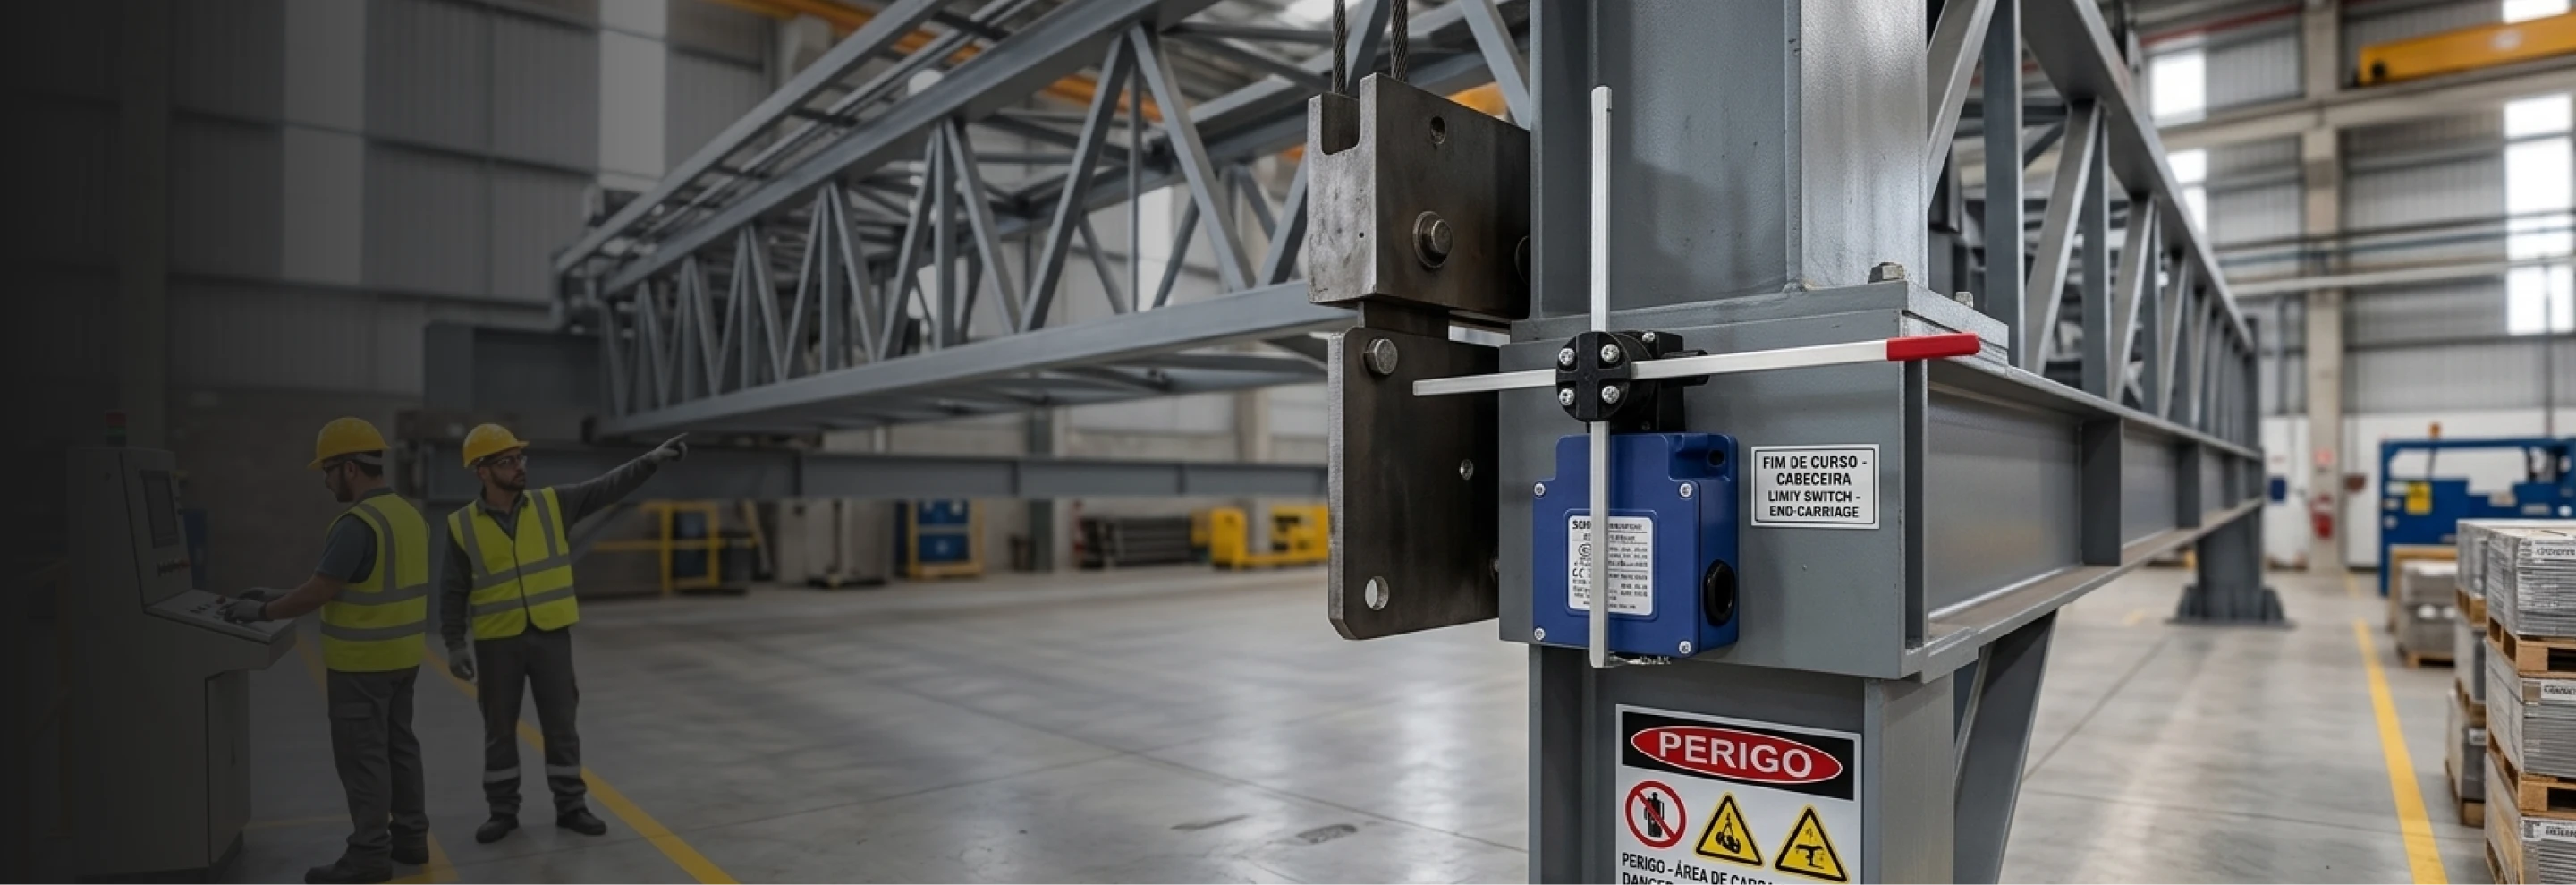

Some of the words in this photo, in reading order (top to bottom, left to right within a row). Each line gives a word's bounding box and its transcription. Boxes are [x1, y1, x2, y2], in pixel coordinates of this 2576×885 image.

[1763, 456, 1786, 469] FIM
[1791, 456, 1808, 469] DE
[1810, 455, 1858, 469] CURSO
[1776, 472, 1852, 486] CABECEIRA
[1804, 490, 1852, 503] SWITCH
[1659, 731, 1812, 778] PERIGO
[1622, 852, 1665, 873] PERIGO
[1674, 859, 1708, 884] ÁREA
[1711, 870, 1728, 885] DE
[1731, 874, 1773, 885] CAR
[1623, 872, 1674, 885] DANG
